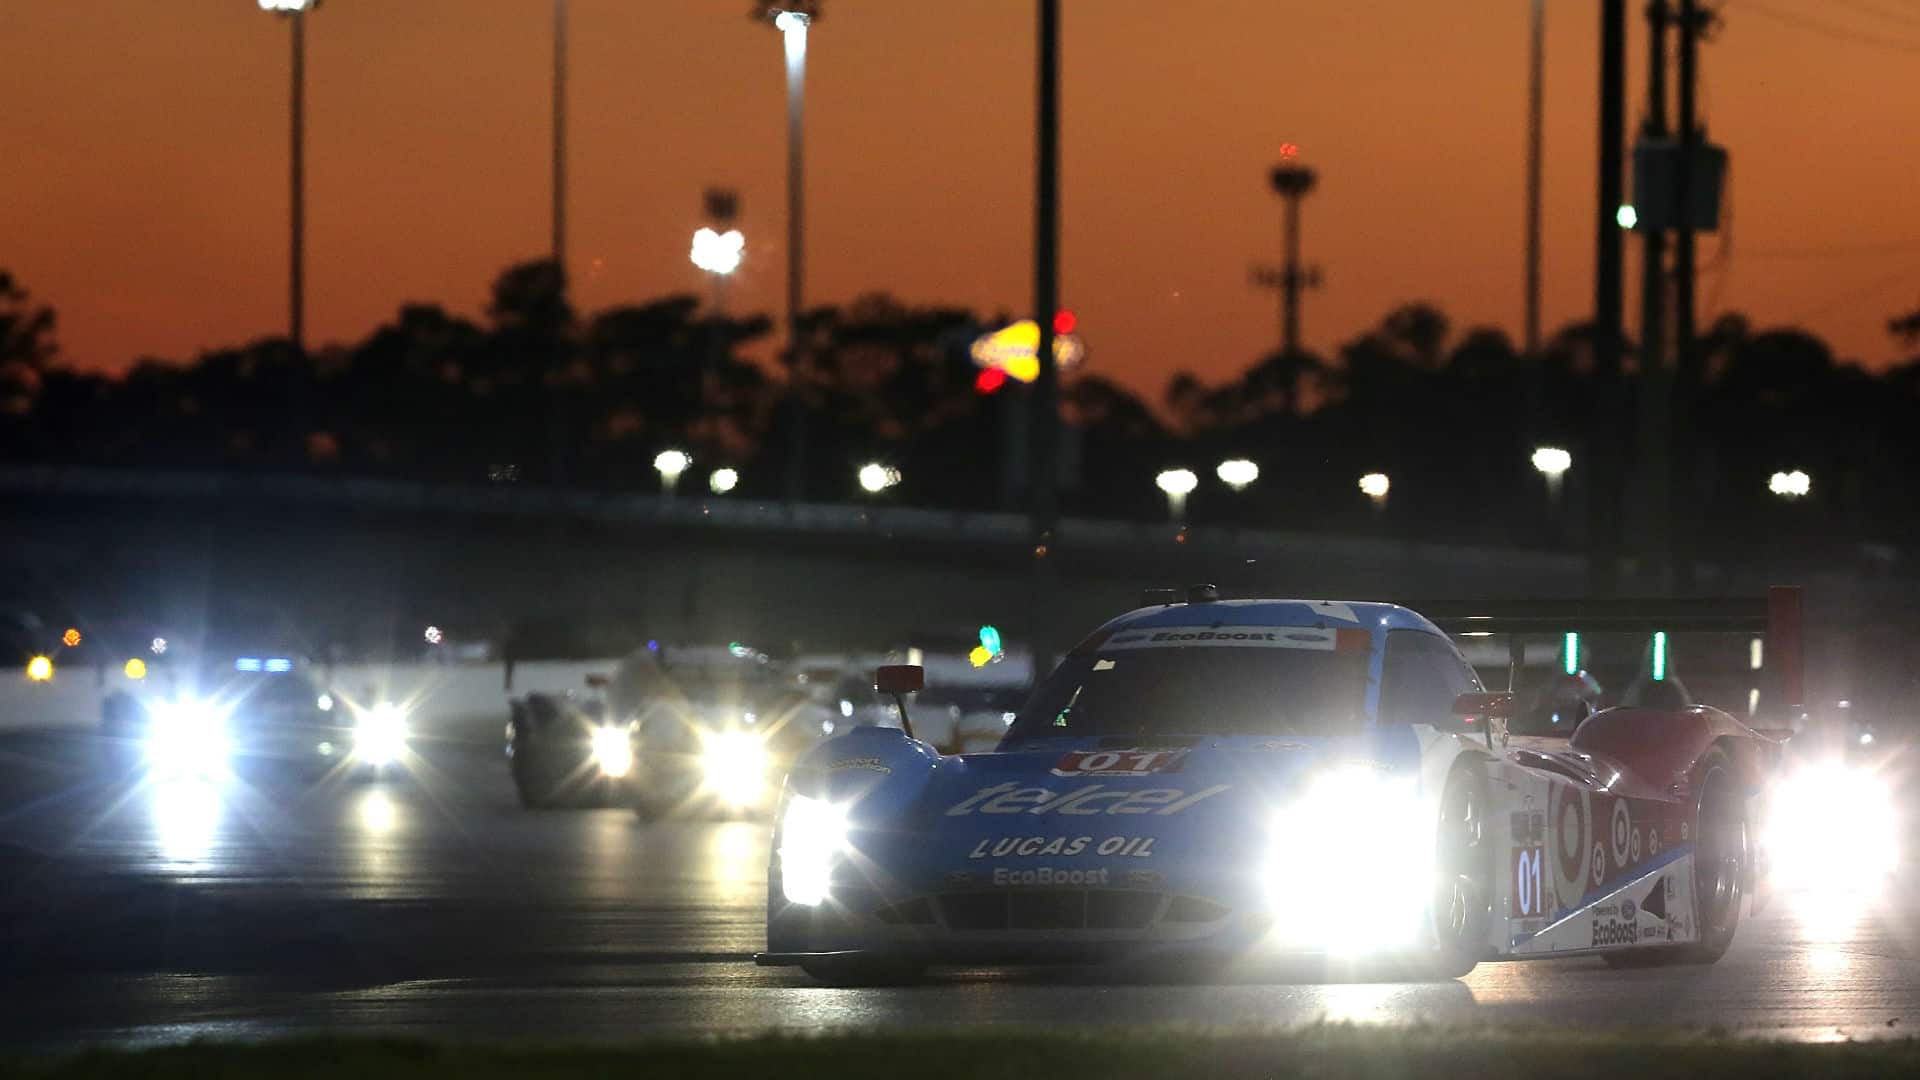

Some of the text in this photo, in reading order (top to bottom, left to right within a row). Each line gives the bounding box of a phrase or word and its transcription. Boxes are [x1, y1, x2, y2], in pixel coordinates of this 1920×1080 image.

[1151, 632, 1276, 641] EcoBoost
[1078, 752, 1150, 771] 01
[945, 782, 1231, 816] telcel
[969, 837, 1156, 858] LUCAS OIL
[993, 868, 1110, 885] EcoBoost
[1518, 849, 1541, 915] 01
[1592, 918, 1638, 945] EcoBoost
